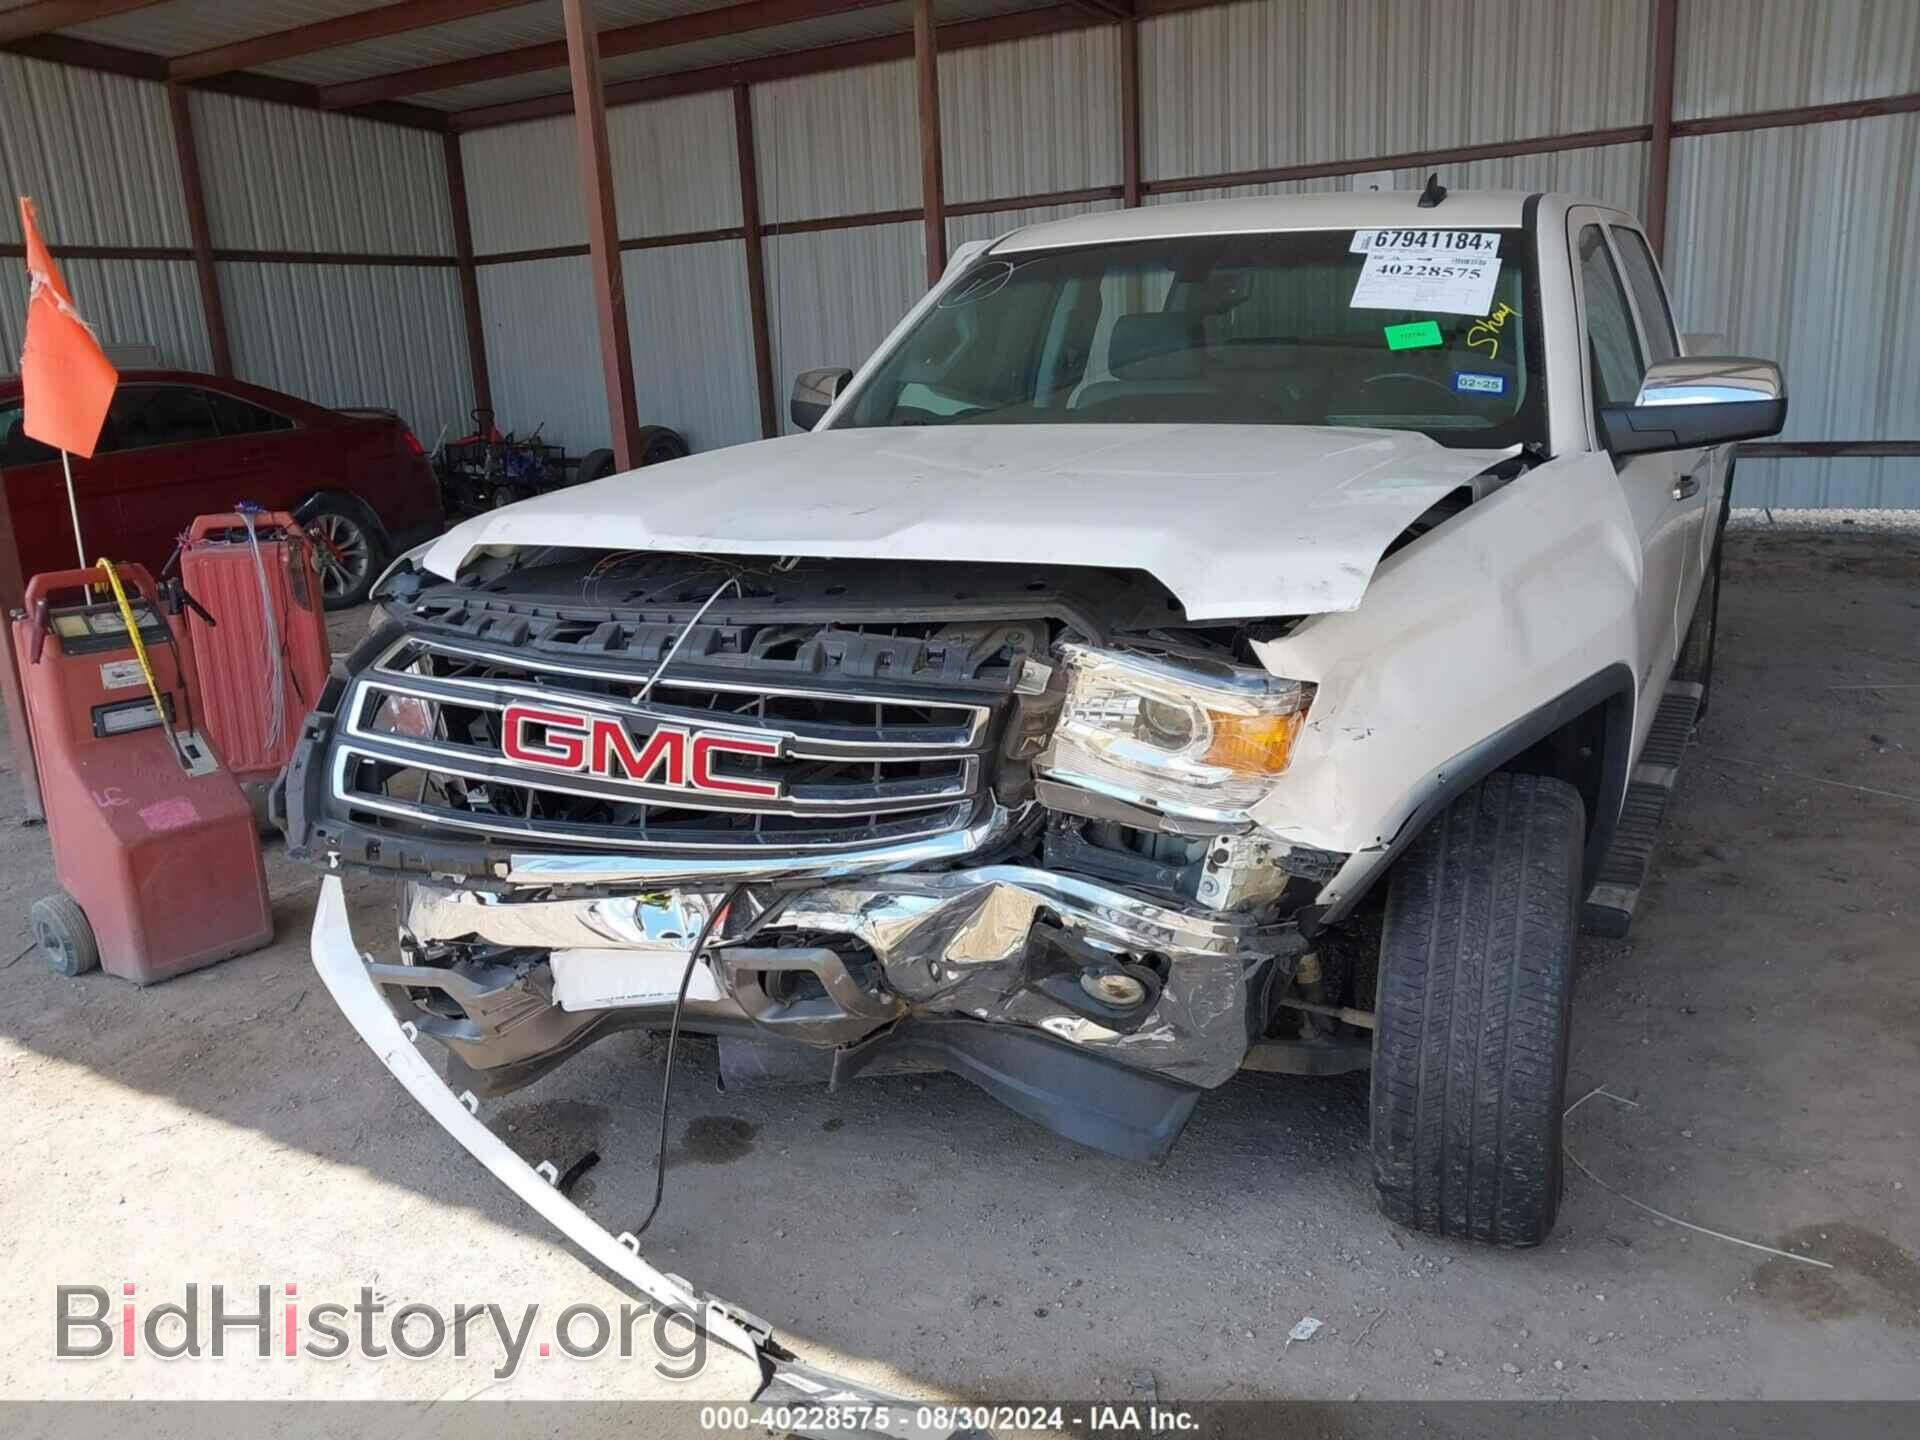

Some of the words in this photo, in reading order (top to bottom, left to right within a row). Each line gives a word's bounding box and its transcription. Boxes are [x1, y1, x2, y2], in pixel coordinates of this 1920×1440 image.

[1375, 264, 1481, 280] 40228575
[1459, 377, 1501, 390] 02-25
[501, 702, 784, 799] GMC
